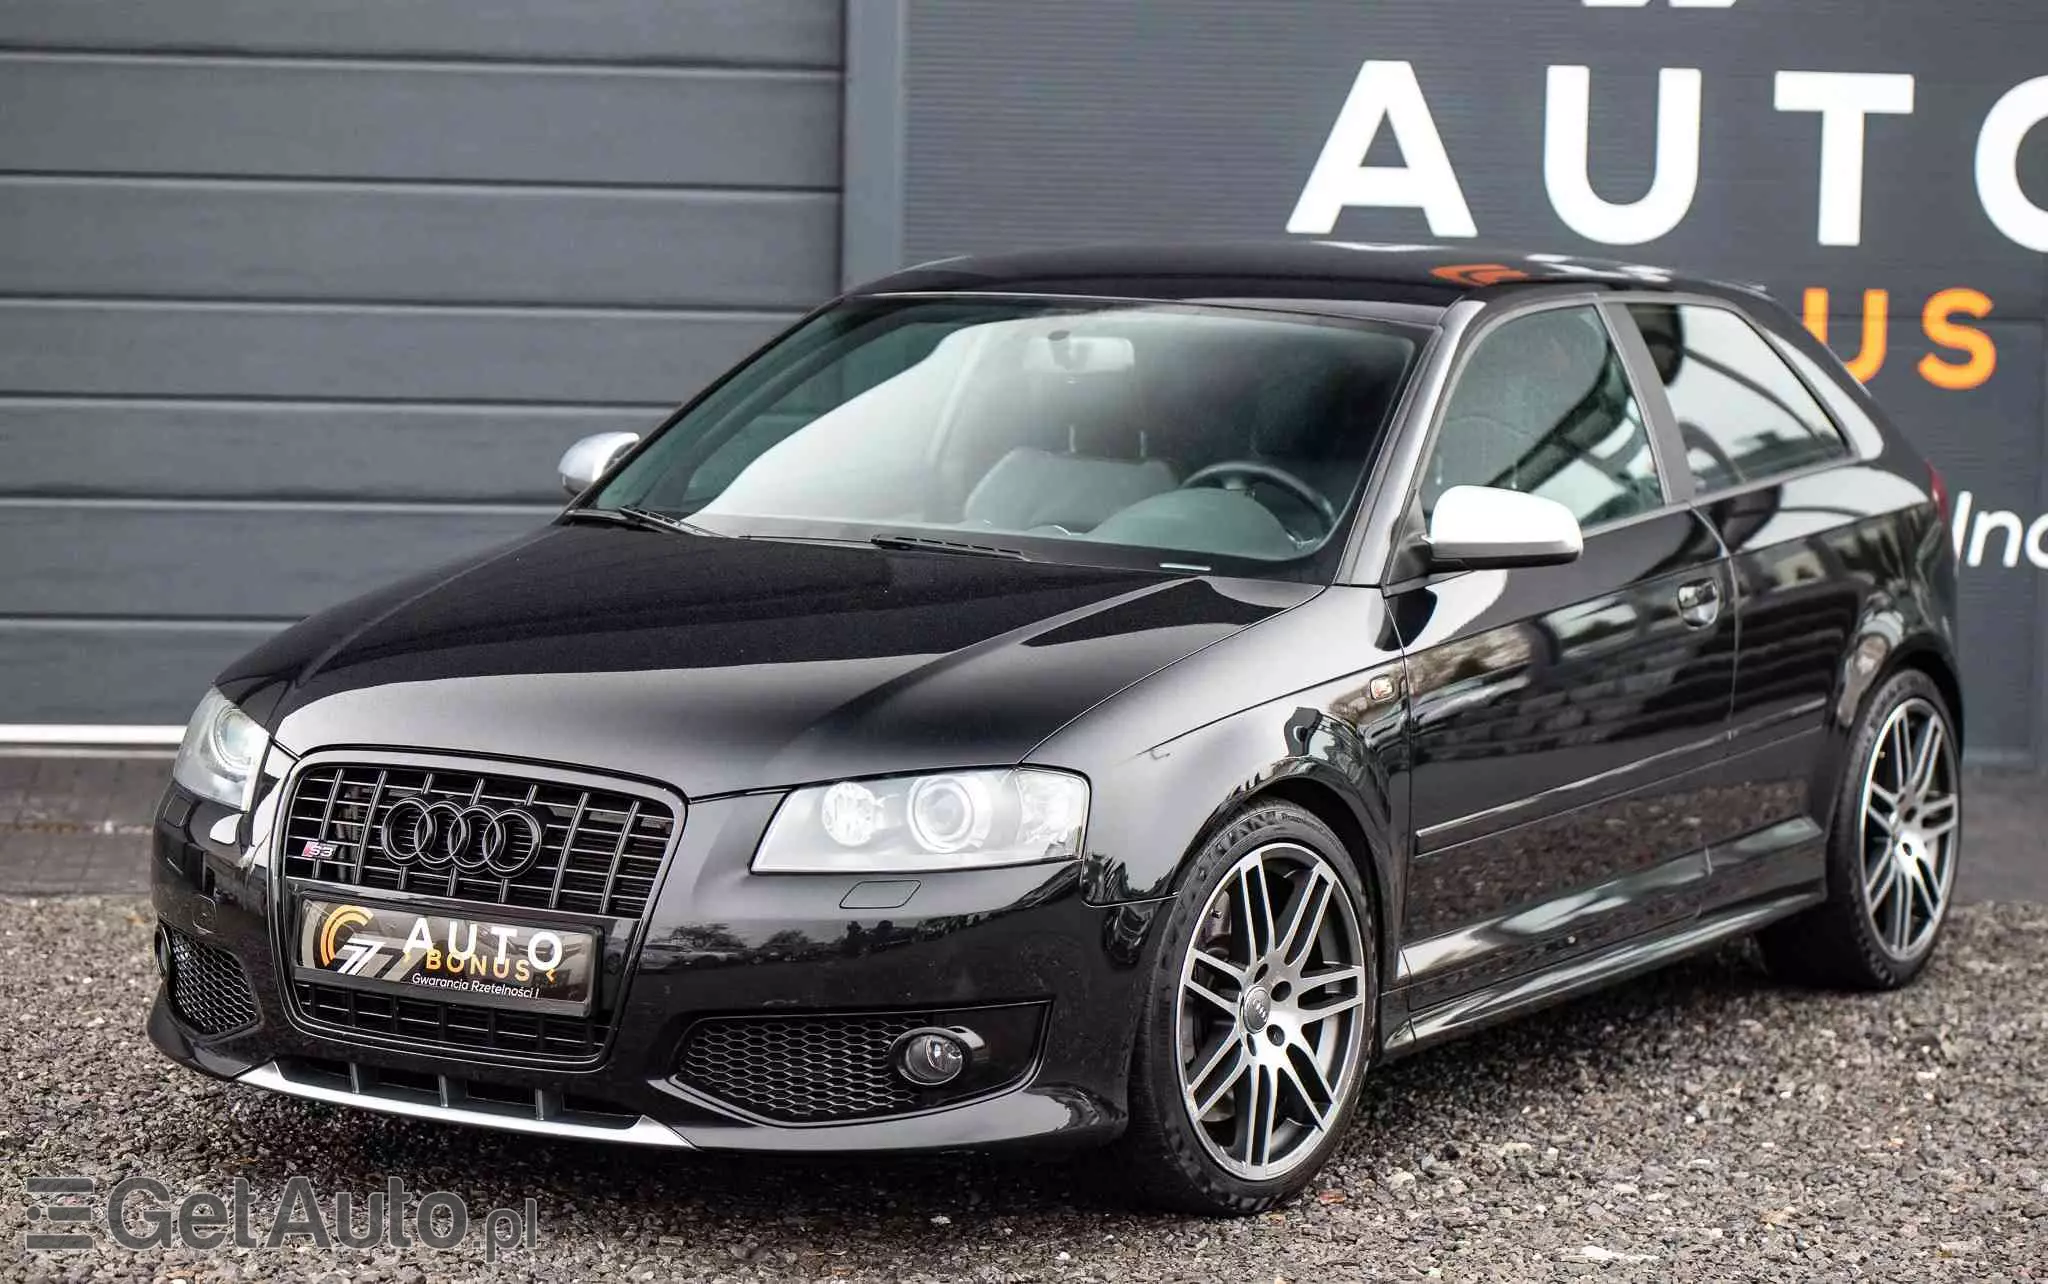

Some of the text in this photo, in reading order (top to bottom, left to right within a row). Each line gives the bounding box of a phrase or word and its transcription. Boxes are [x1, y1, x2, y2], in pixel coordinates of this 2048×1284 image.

[306, 843, 334, 857] S3
[402, 917, 563, 971] AUTO
[425, 949, 531, 982] BONUS
[412, 972, 469, 991] Gwarancja
[471, 980, 533, 999] Rzetelności
